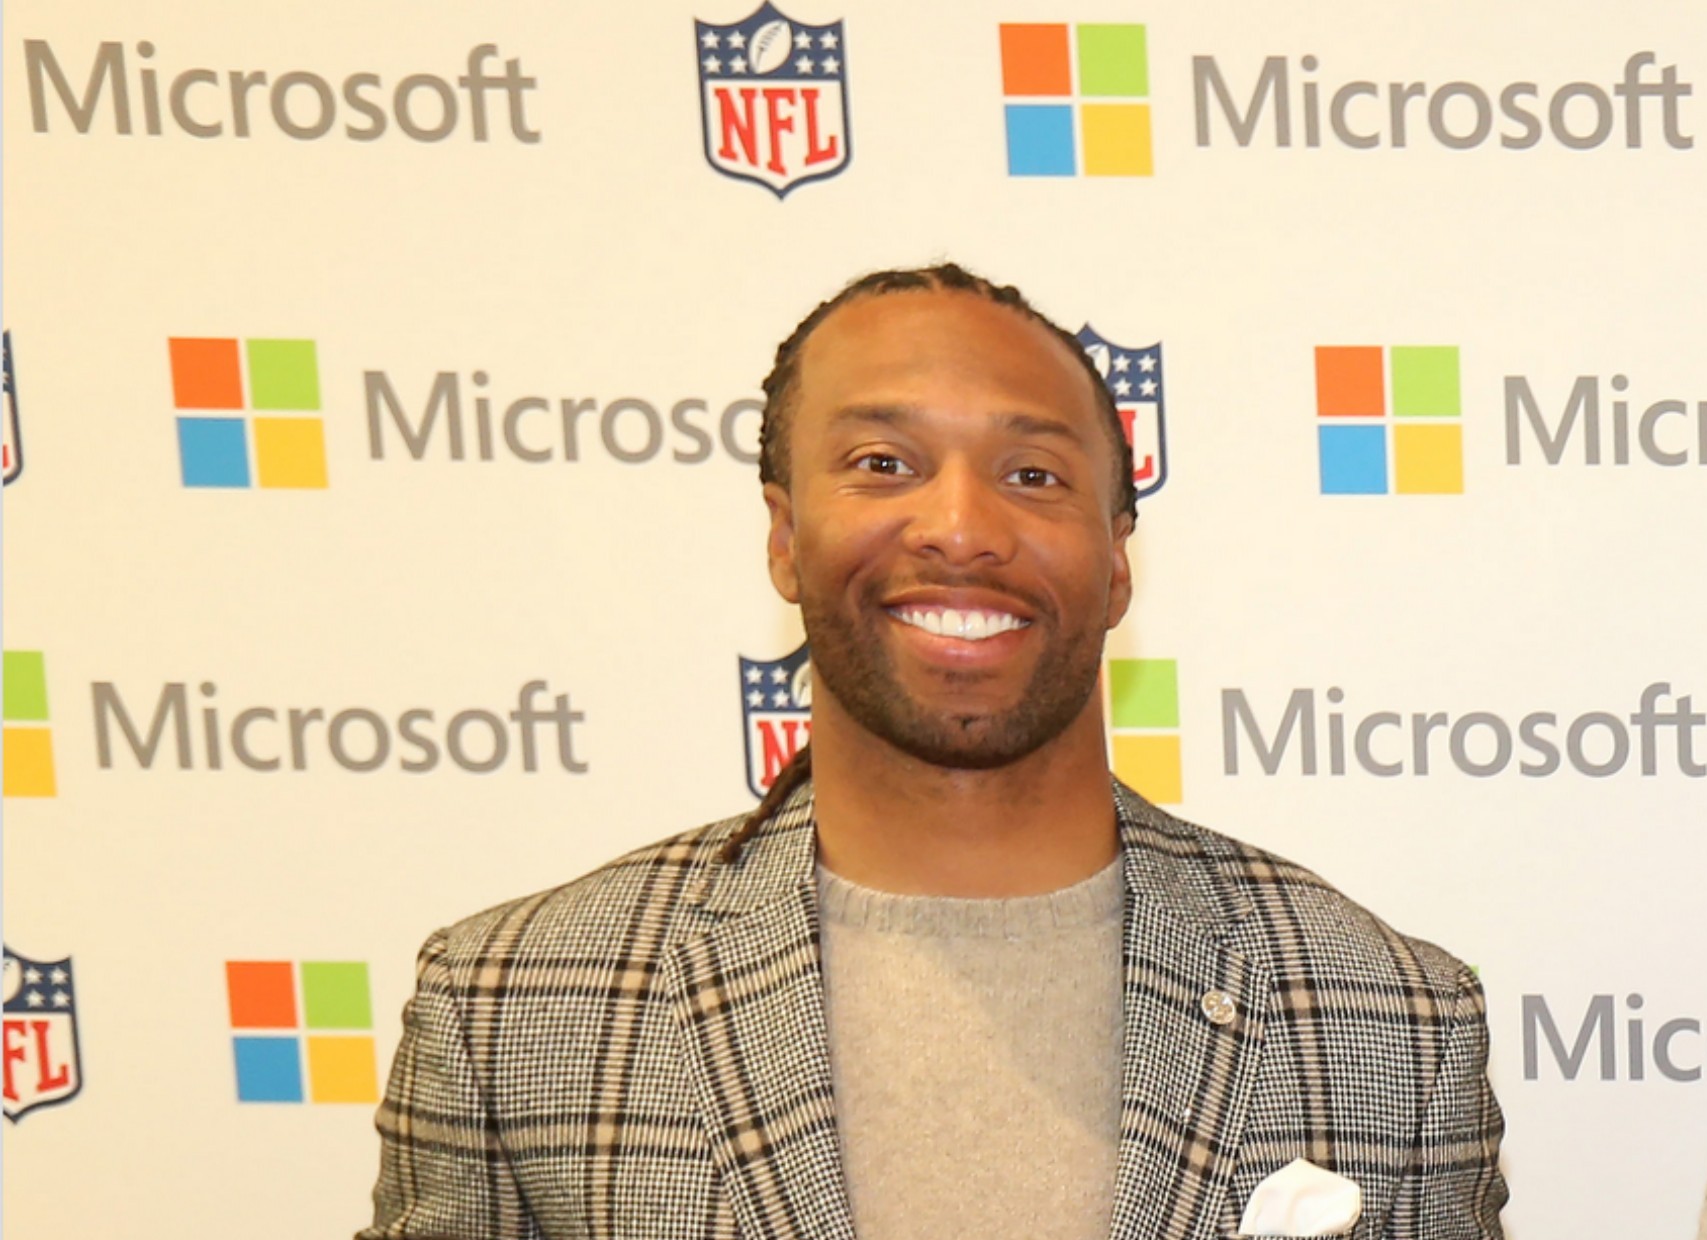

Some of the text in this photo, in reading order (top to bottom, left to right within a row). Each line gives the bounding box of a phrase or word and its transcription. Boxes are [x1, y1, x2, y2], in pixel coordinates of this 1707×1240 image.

[24, 39, 540, 143] Microsoft
[715, 89, 837, 175] NFL
[1192, 51, 1693, 150] Microsoft
[364, 371, 758, 466] Microso
[91, 680, 588, 774] Microsoft
[1222, 682, 1707, 776] Microsoft
[4, 1019, 69, 1103] FL
